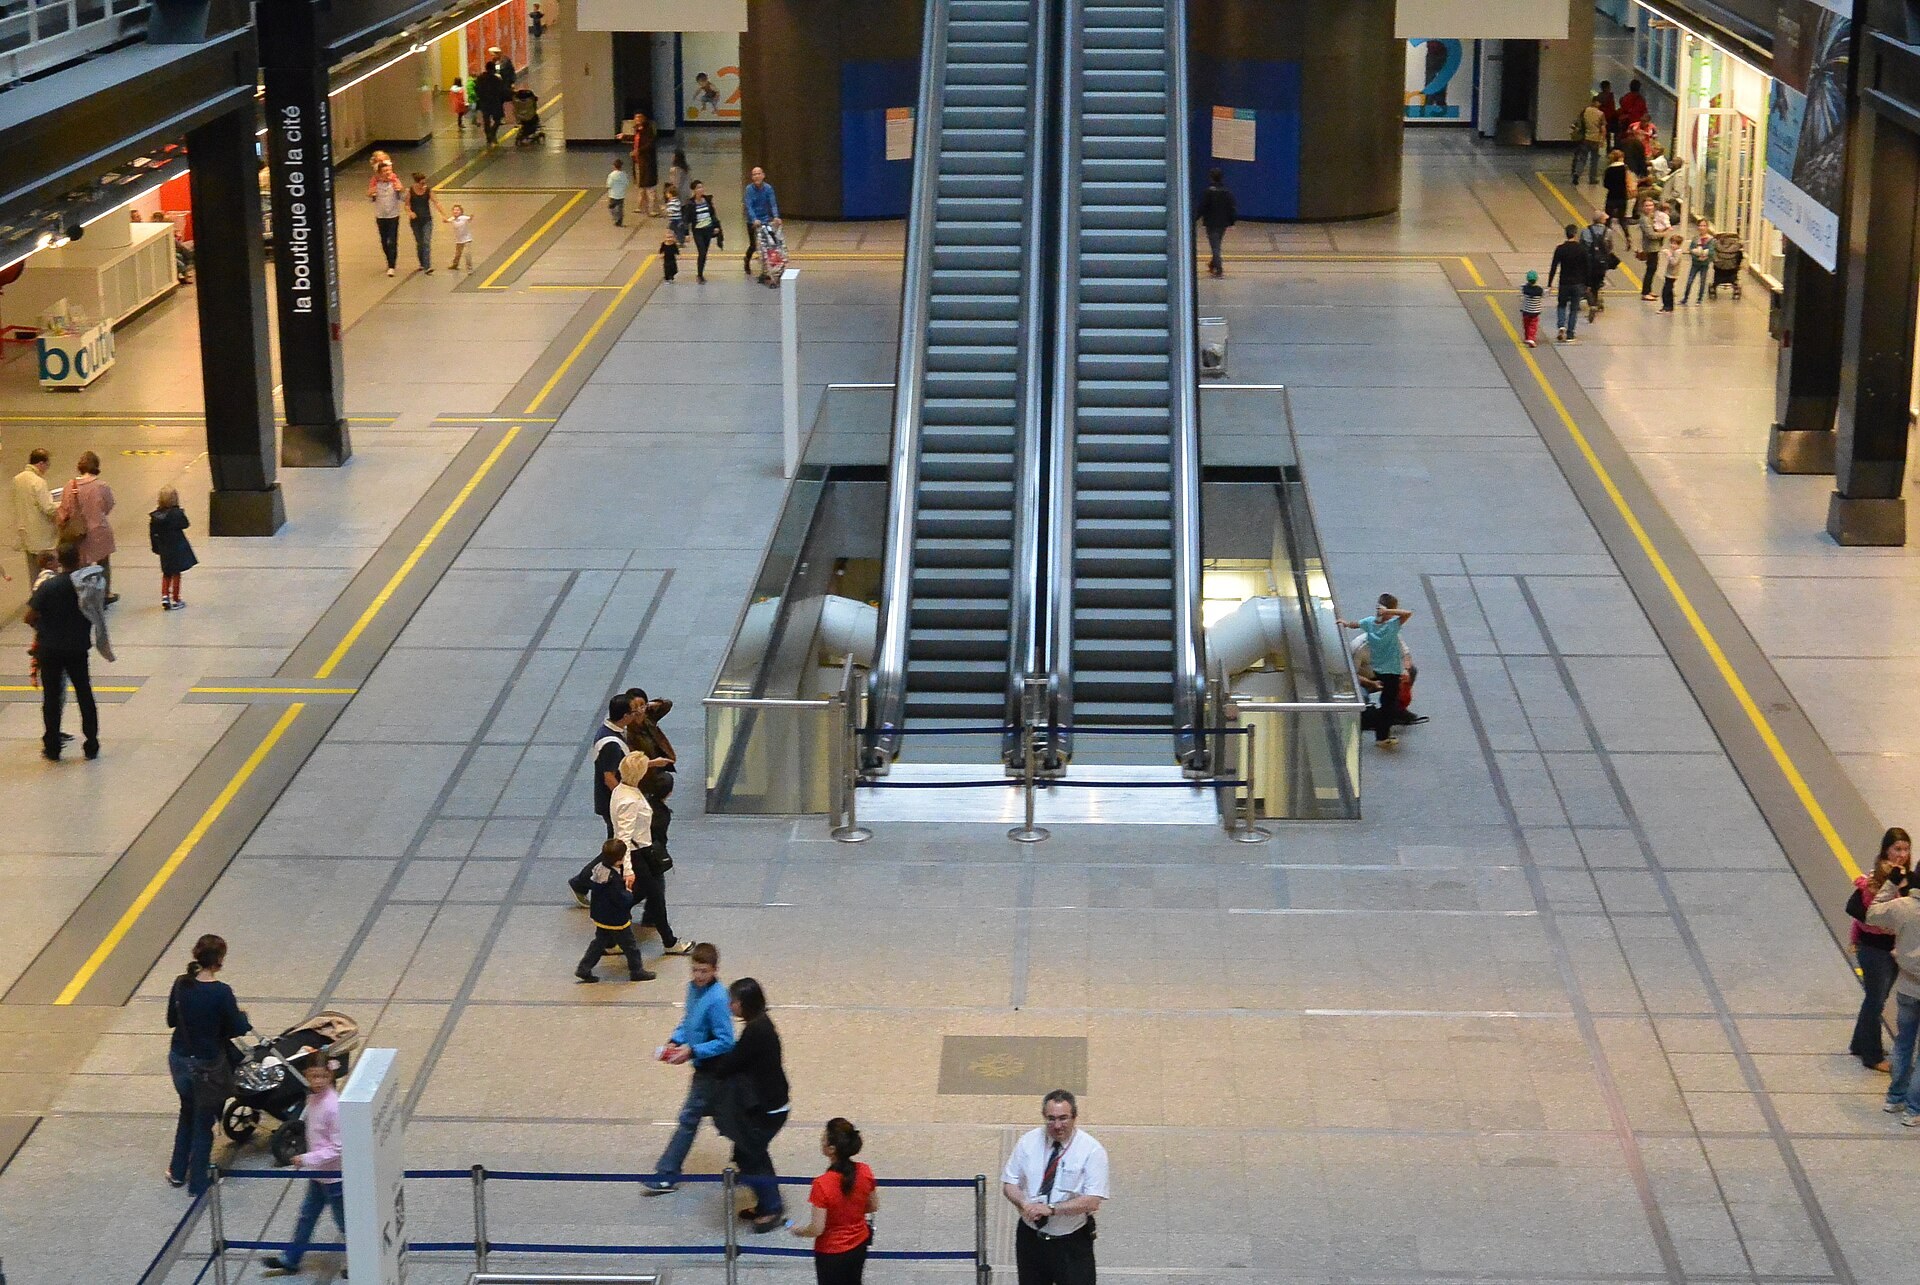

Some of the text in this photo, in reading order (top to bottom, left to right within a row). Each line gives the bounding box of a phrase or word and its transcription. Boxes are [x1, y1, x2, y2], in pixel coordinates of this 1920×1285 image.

[281, 105, 312, 313] la boutique de la cité
